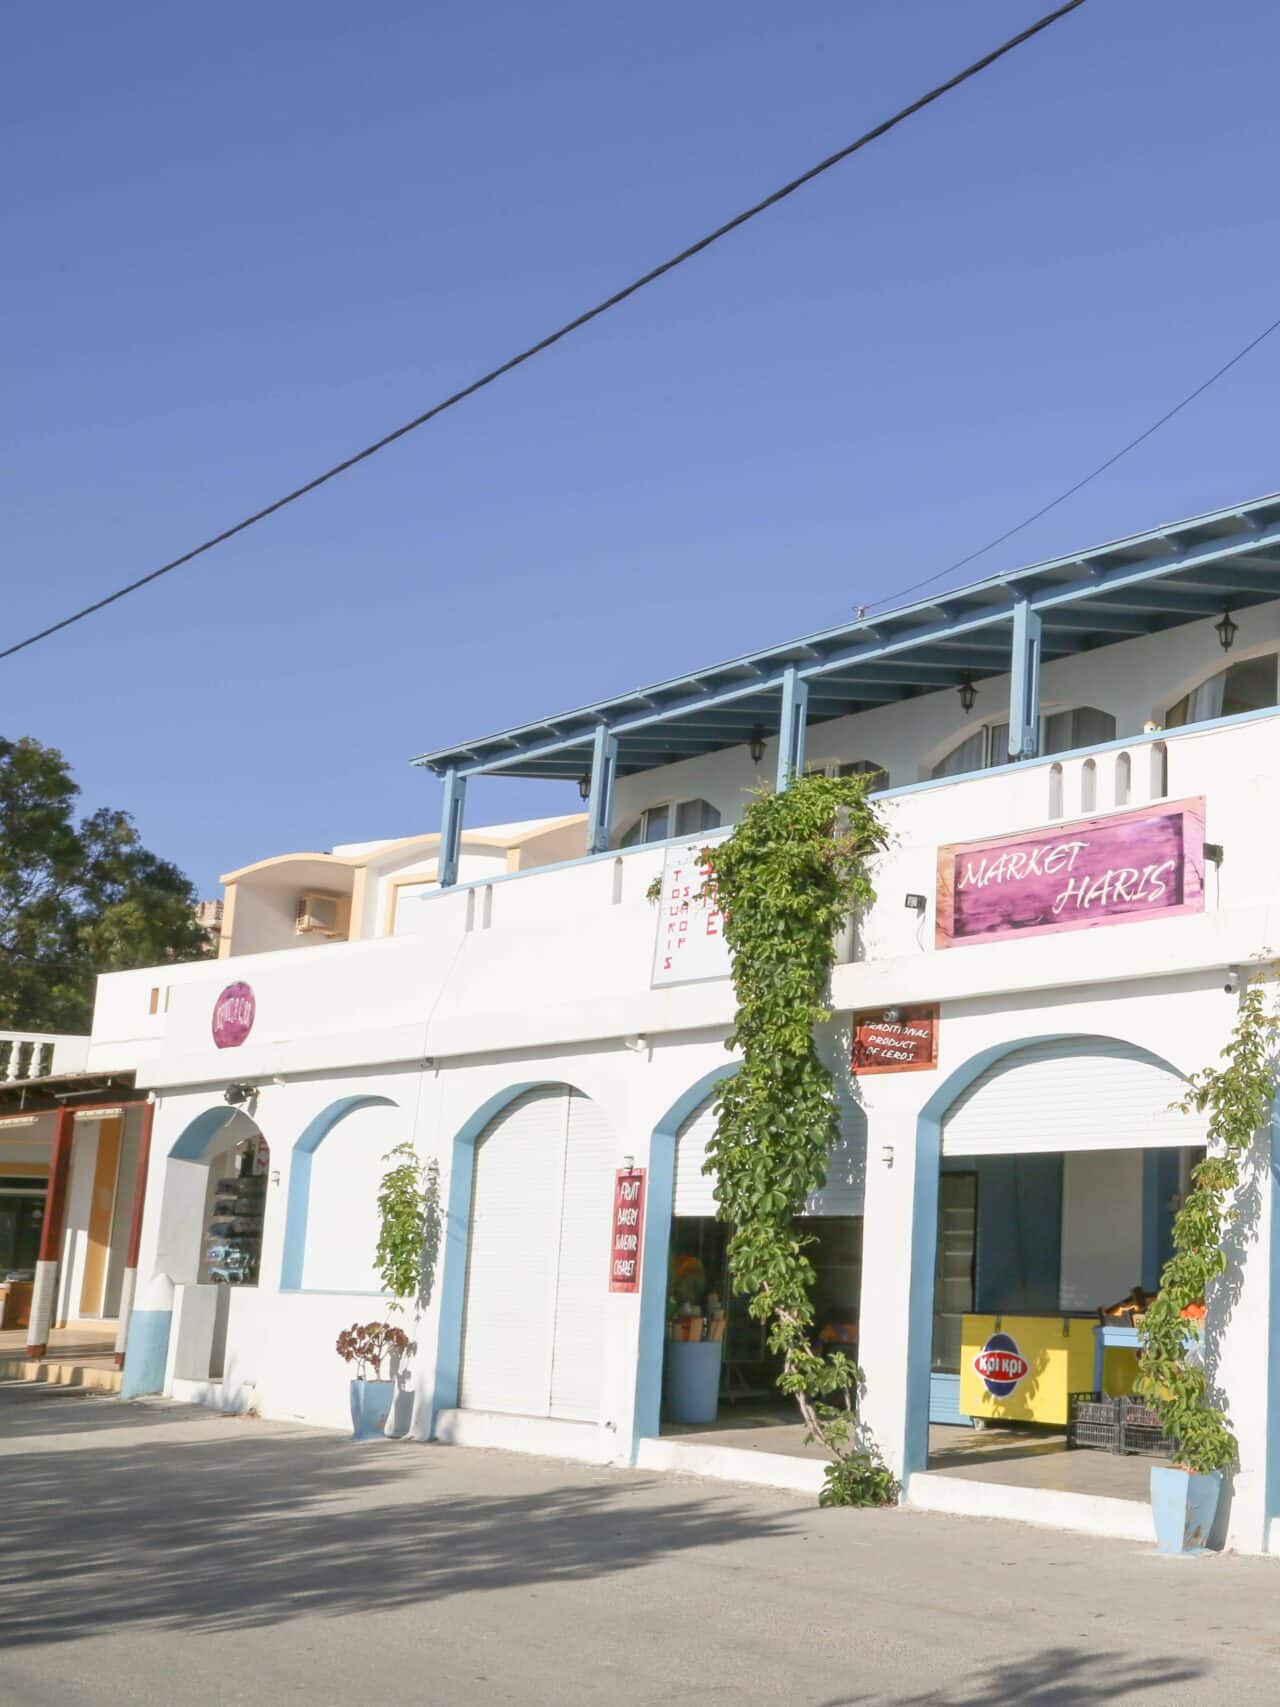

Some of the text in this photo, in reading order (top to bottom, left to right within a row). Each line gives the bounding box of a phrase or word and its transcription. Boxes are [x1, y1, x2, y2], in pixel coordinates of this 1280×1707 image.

[957, 841, 1089, 889] MARKET
[1052, 860, 1176, 915] HARIS
[864, 1020, 929, 1039] TRADITIONAL
[867, 1034, 917, 1050] PRODUCT
[866, 1045, 914, 1061] OF LEROS
[620, 1181, 640, 1201] FRUIT
[617, 1207, 639, 1226] BAKERY
